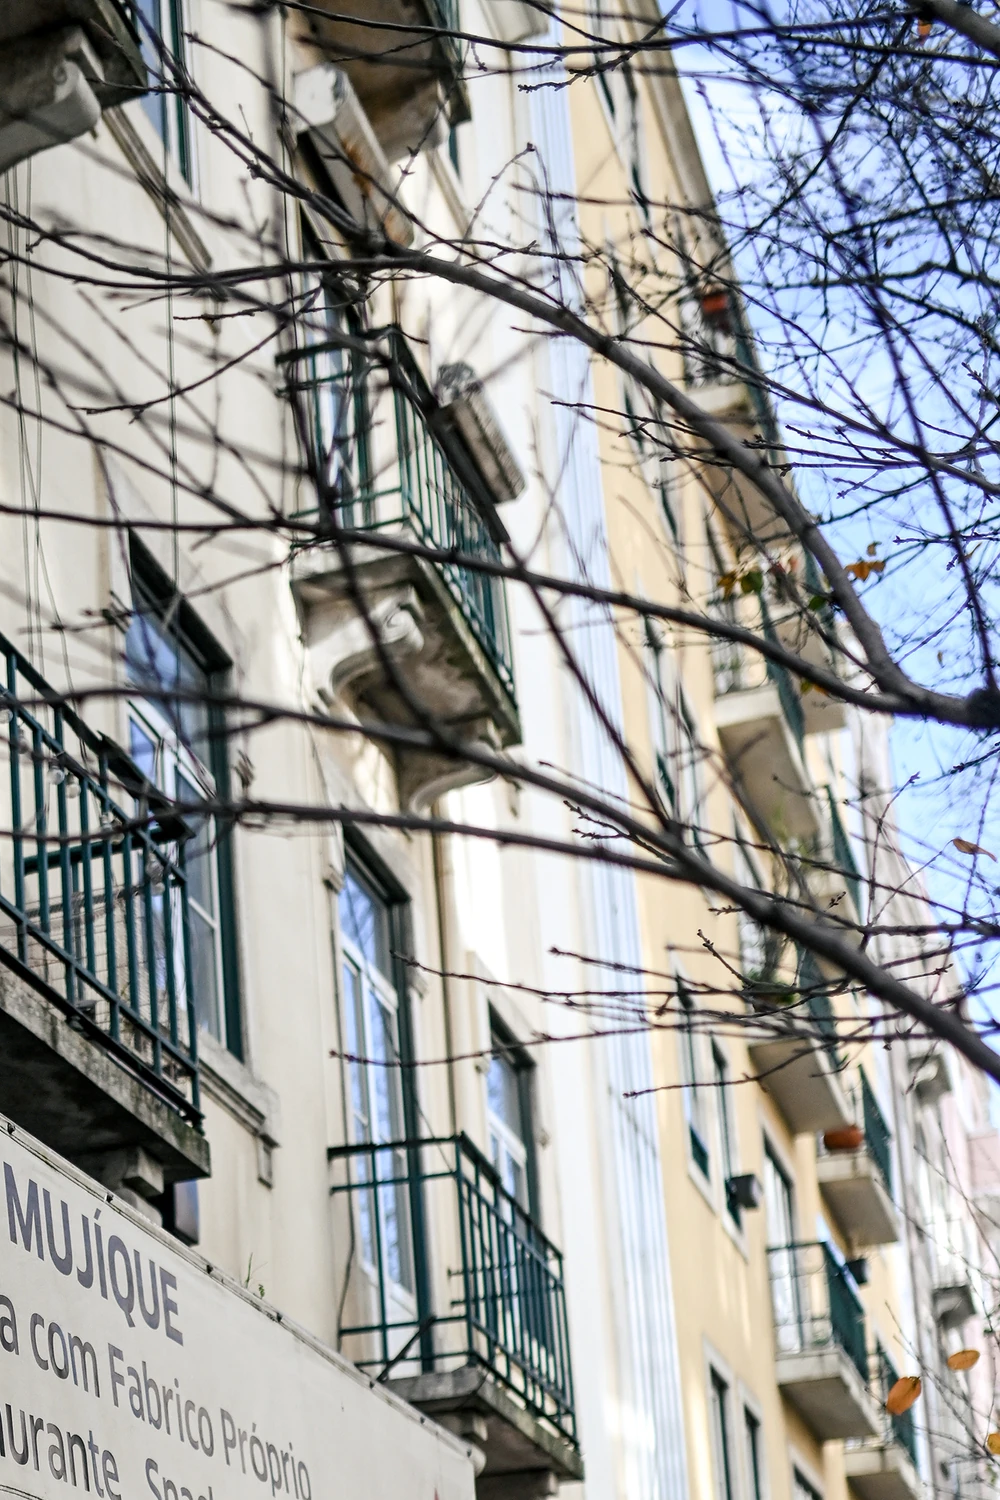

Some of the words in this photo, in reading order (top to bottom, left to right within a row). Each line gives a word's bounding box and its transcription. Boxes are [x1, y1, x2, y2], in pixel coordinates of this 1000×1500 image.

[2, 1161, 183, 1346] MUJÍQUE
[30, 1313, 100, 1399] com
[107, 1341, 214, 1457] Fabrico
